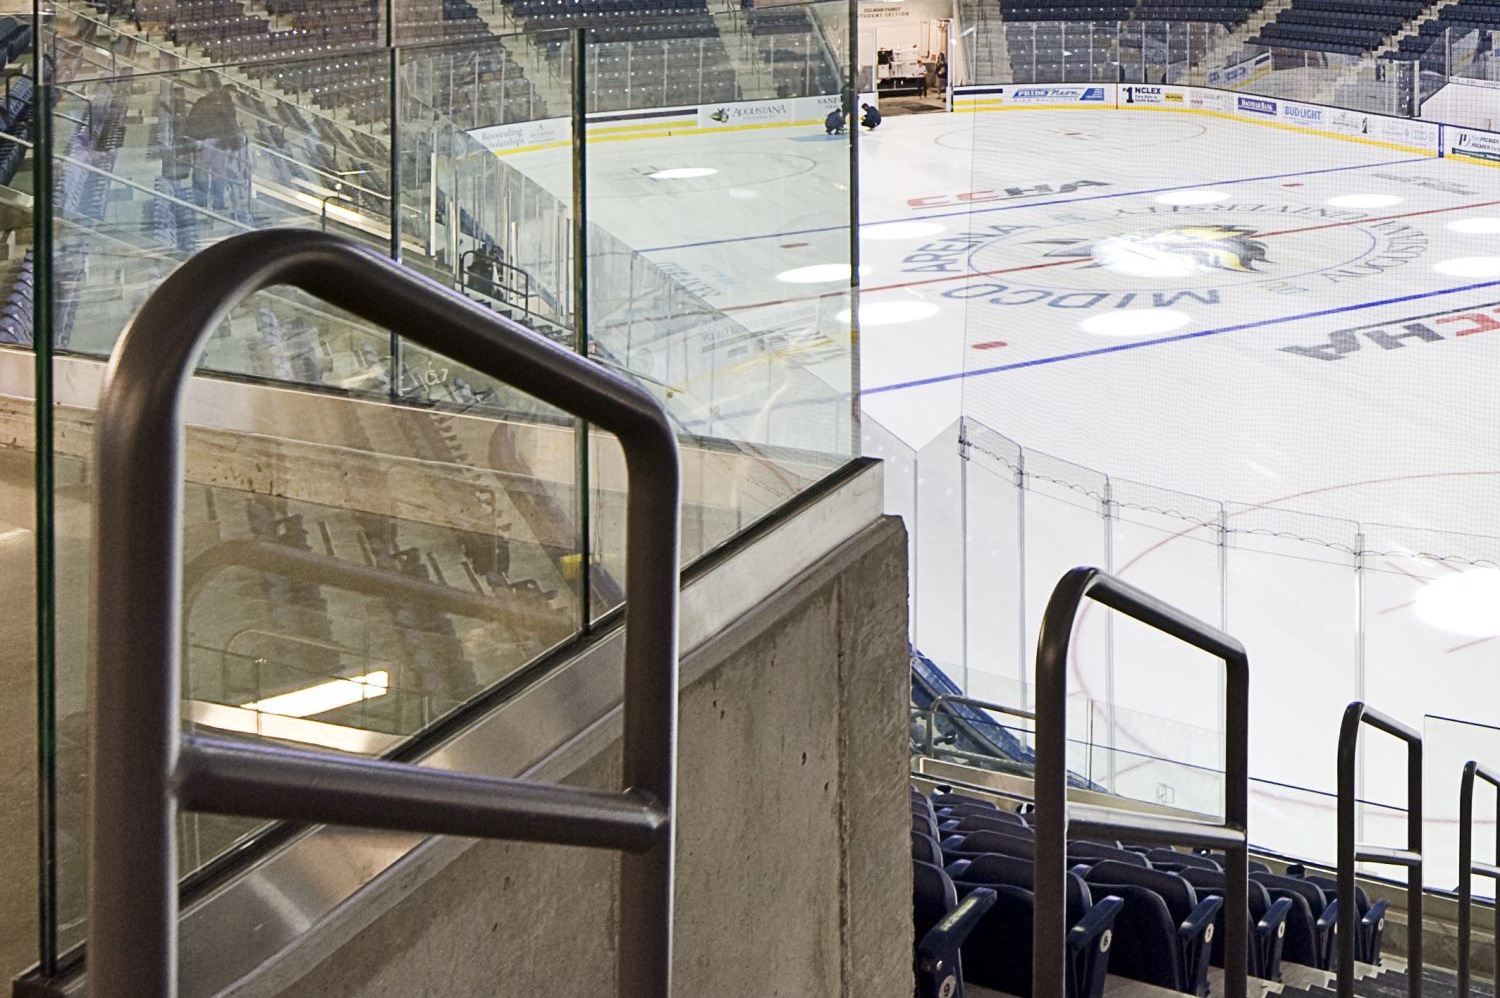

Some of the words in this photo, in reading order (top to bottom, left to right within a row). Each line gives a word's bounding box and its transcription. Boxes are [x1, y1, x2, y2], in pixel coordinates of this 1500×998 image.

[1285, 105, 1300, 116] BUD
[1300, 108, 1322, 120] LIGHT
[906, 179, 1113, 208] CCHA
[900, 223, 1042, 274] ARENA
[940, 283, 1222, 309] MIDCO
